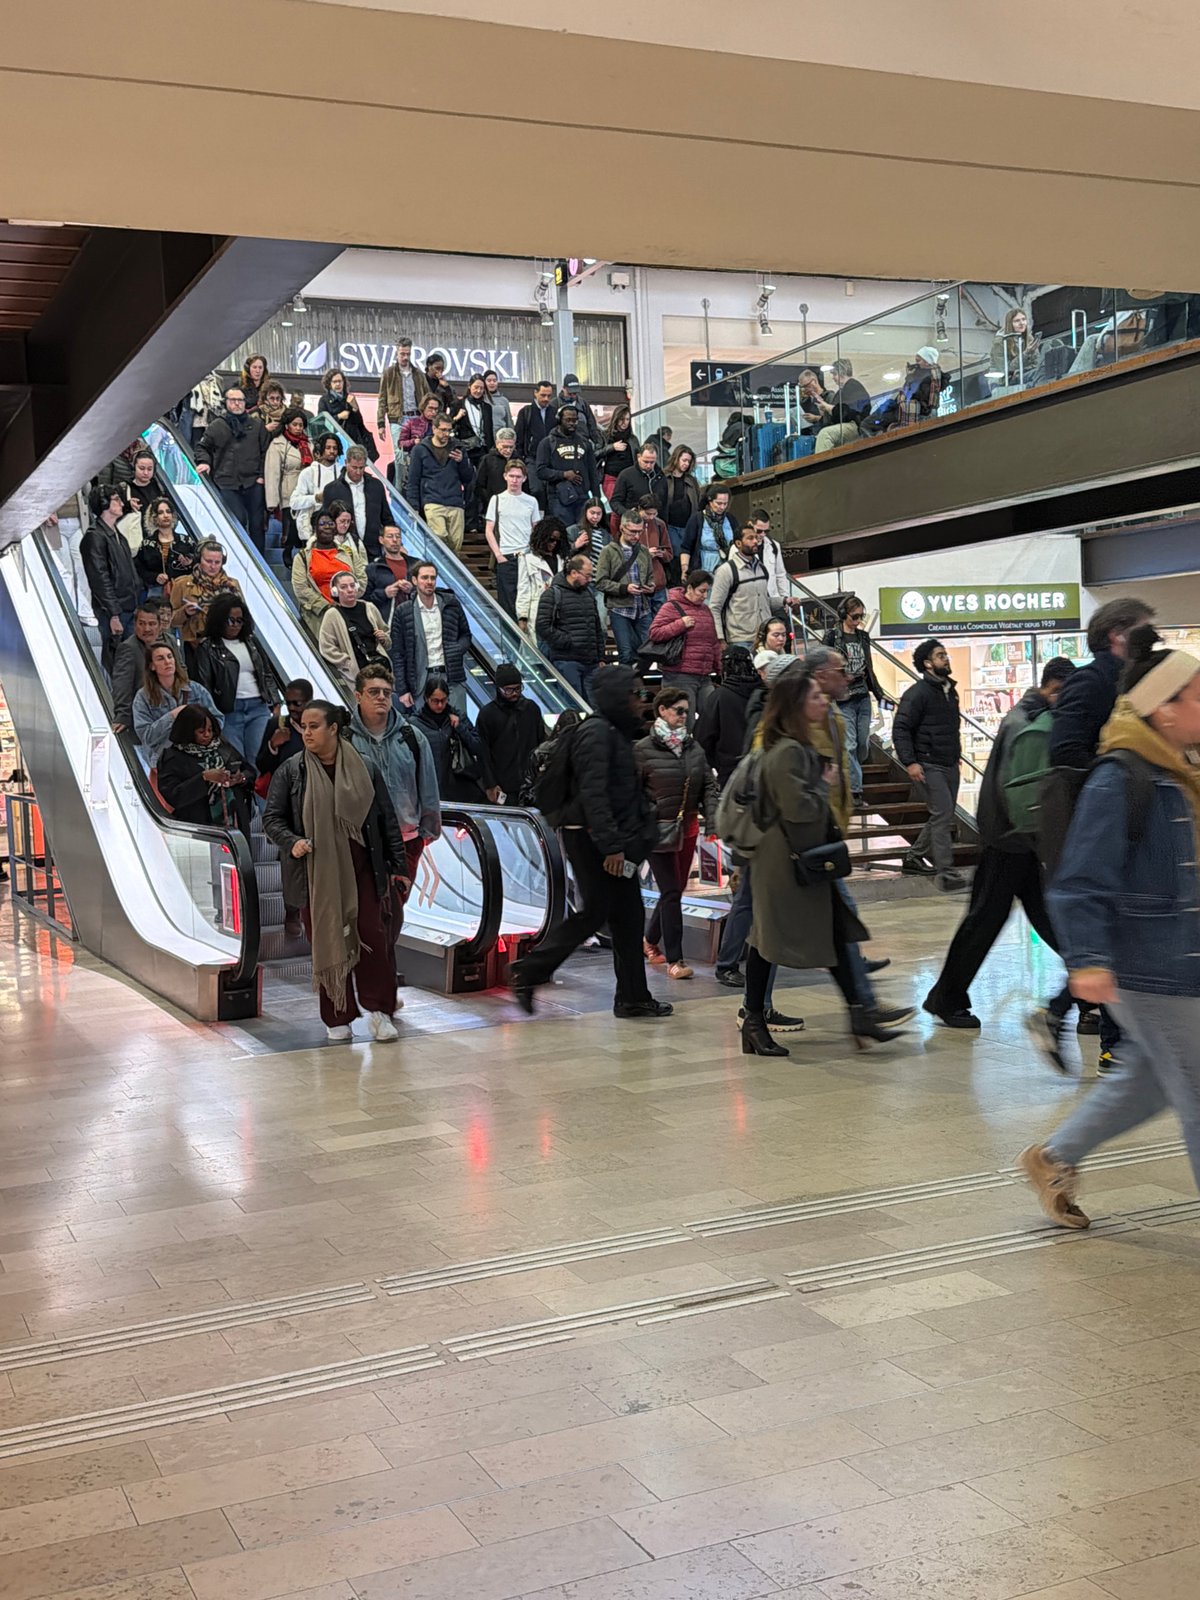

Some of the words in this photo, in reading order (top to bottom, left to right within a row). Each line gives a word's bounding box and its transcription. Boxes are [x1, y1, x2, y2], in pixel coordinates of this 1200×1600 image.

[927, 593, 979, 613] YVES
[984, 592, 1066, 611] ROCHER
[1041, 620, 1056, 628] 1959
